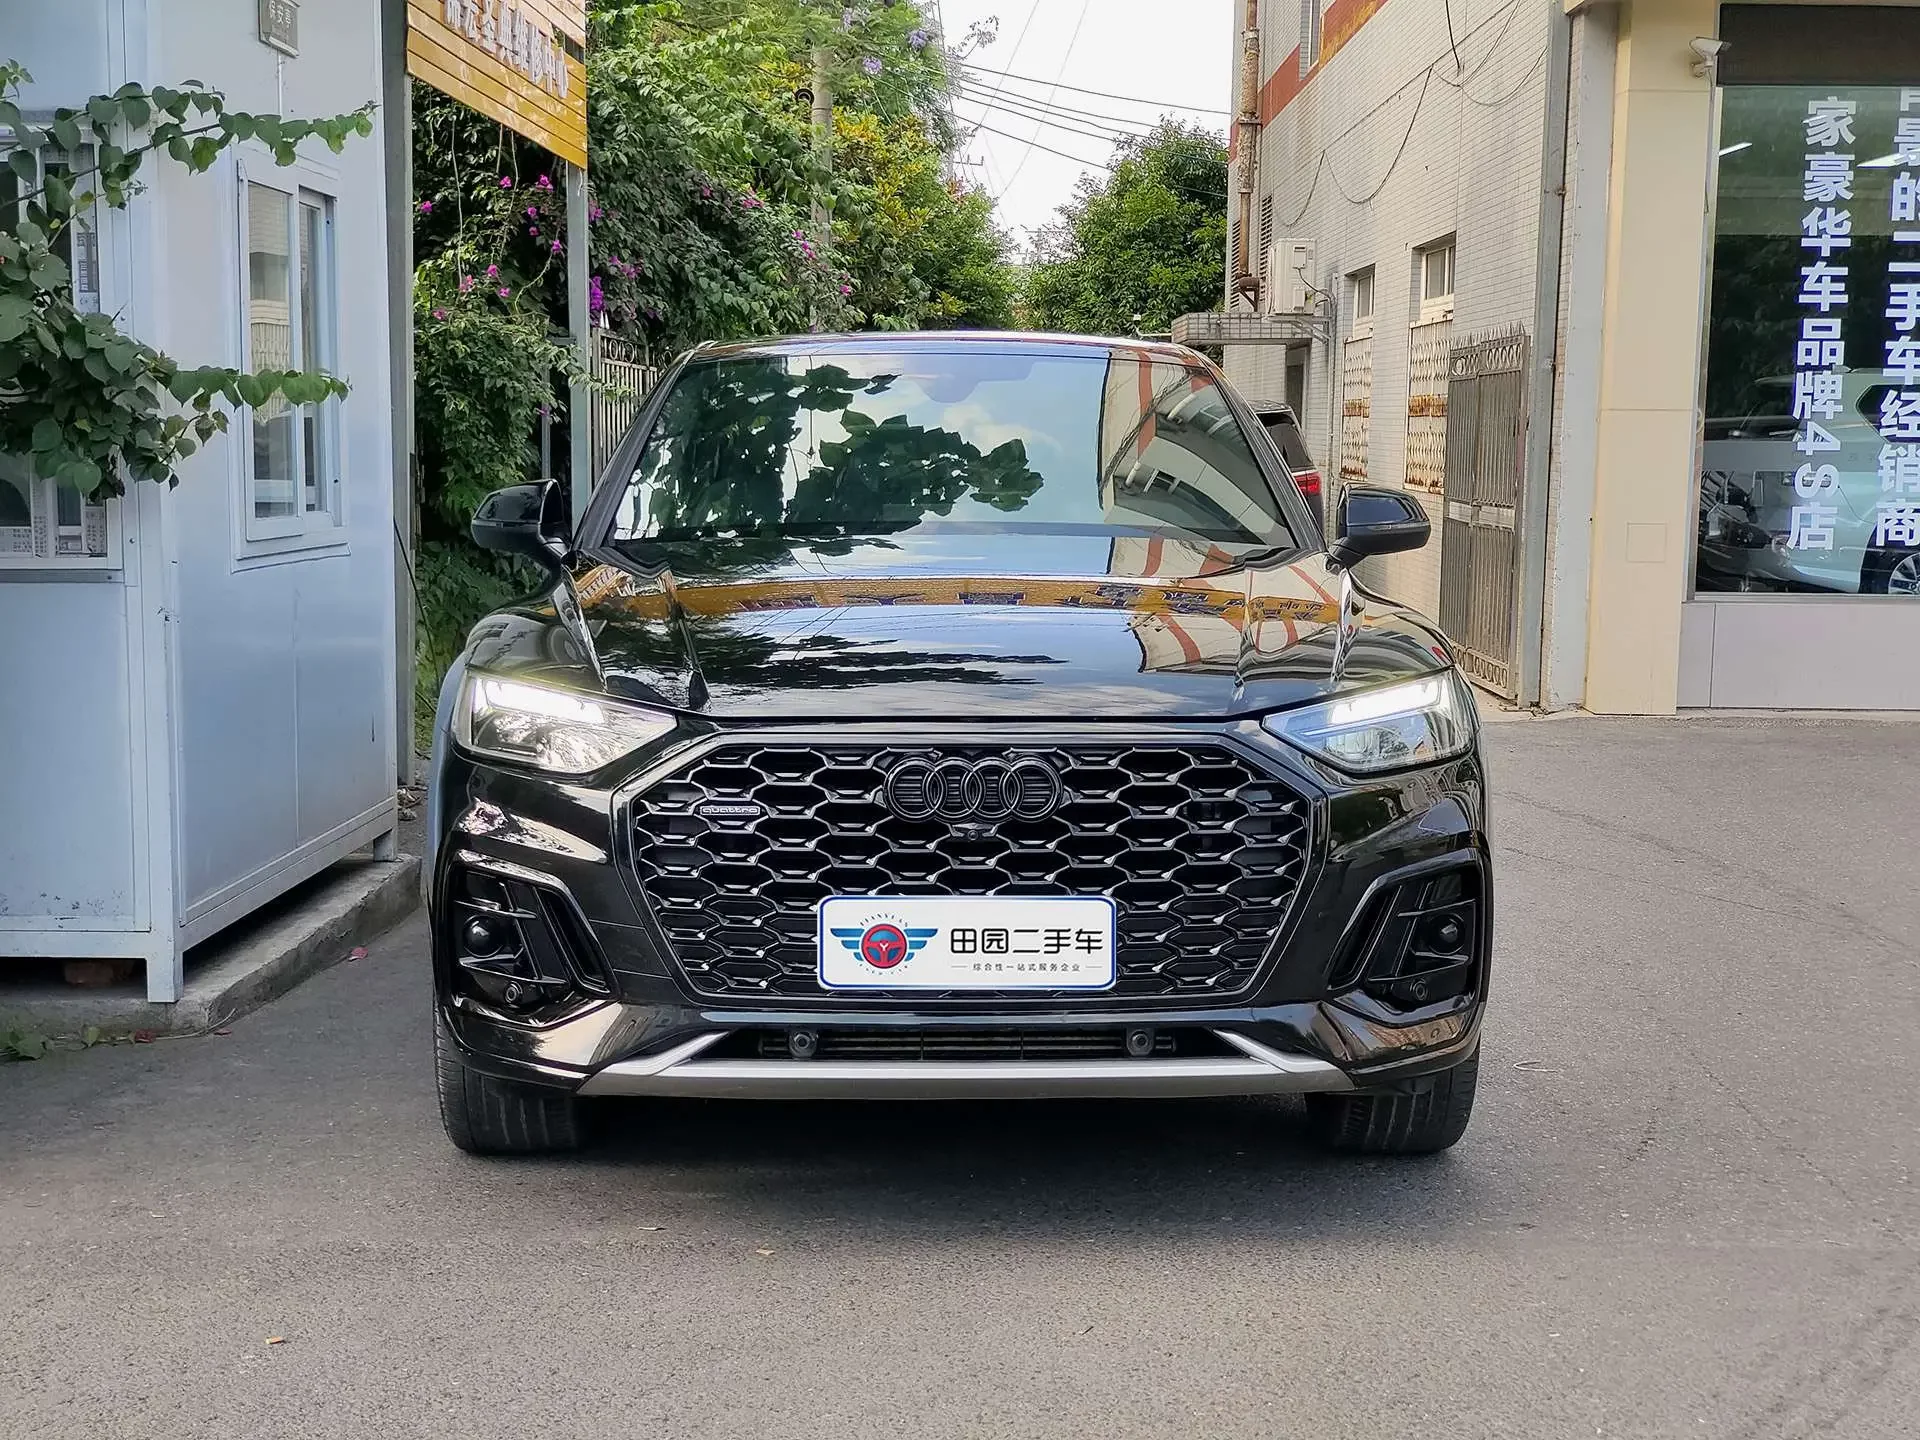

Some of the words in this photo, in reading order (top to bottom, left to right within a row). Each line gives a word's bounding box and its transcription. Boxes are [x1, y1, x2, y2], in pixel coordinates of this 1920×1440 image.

[1786, 96, 1856, 551] 家豪华车品牌4S店
[951, 928, 1103, 954] 田园二手车
[973, 963, 1080, 972] 综合性一站式服务企业
